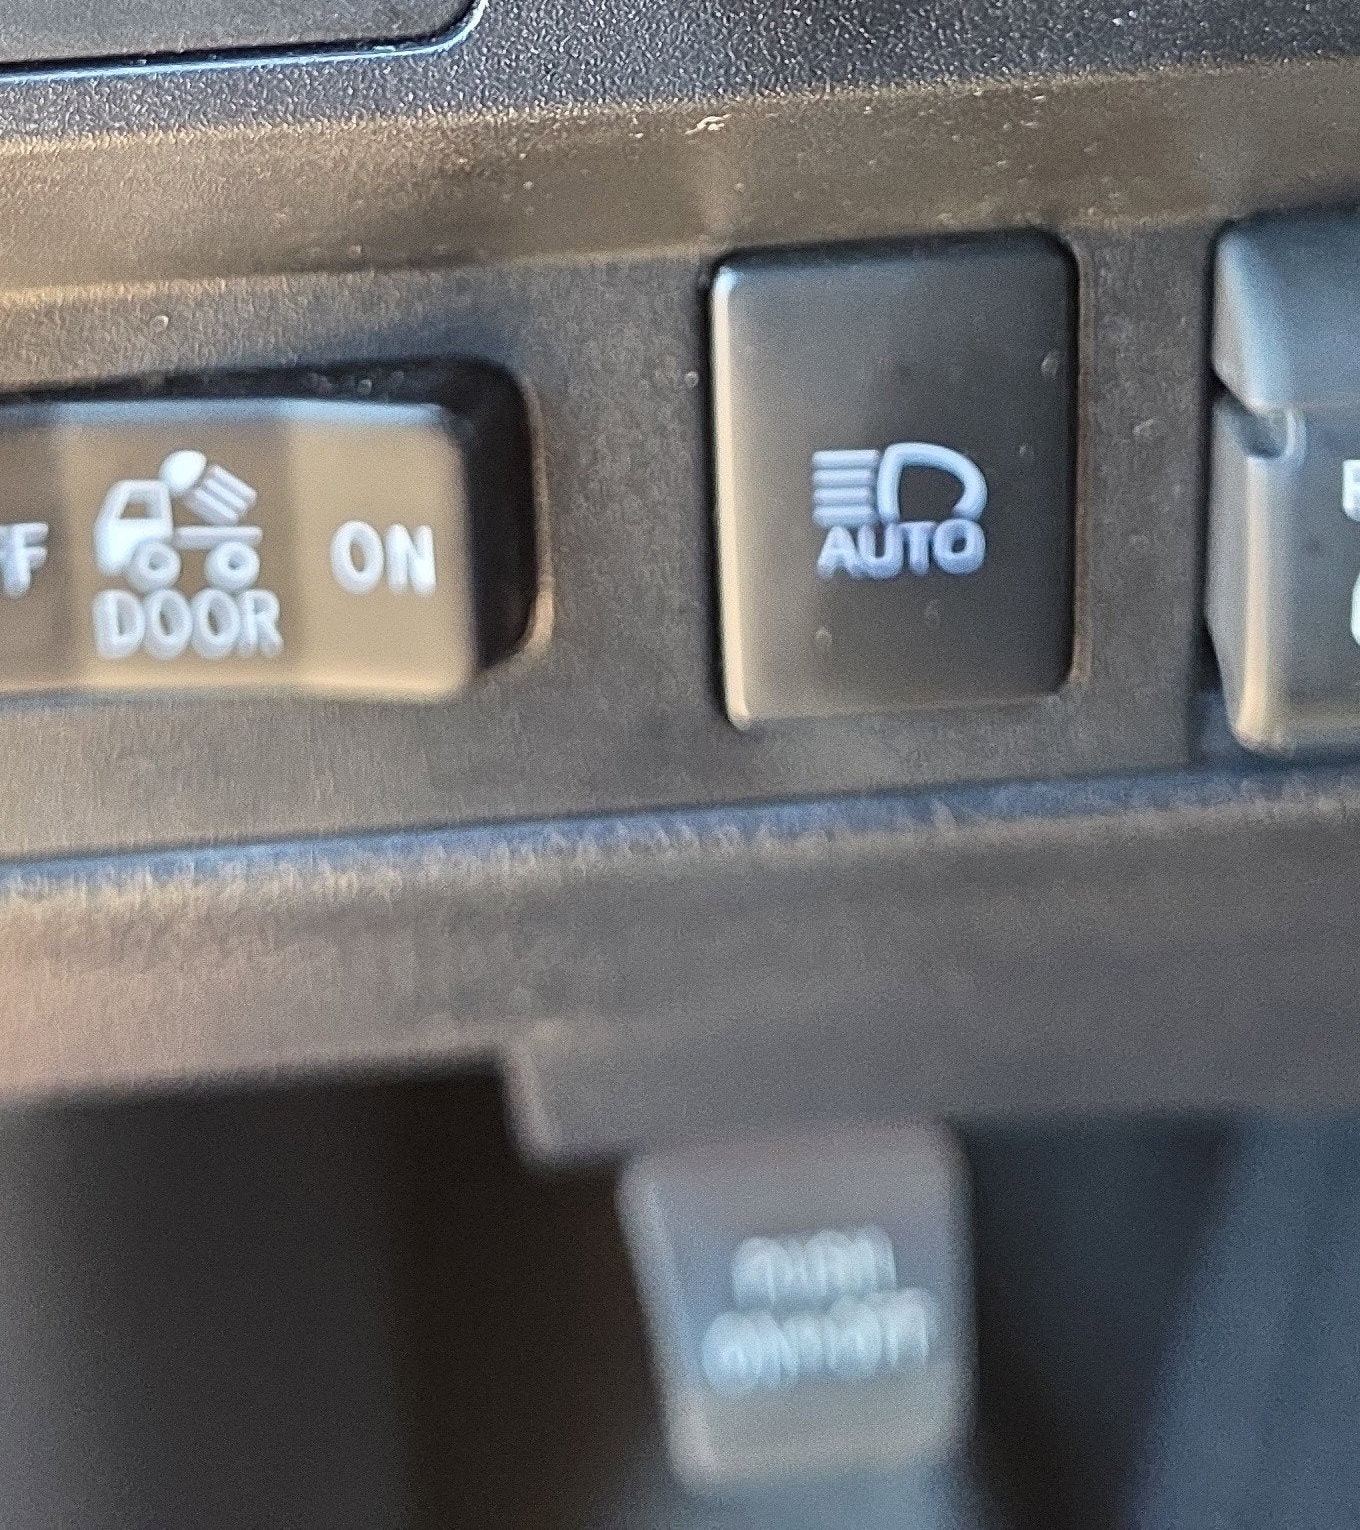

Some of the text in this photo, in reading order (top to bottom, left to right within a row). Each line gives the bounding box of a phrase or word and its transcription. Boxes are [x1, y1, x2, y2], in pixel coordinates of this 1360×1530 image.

[328, 519, 437, 597] ON
[814, 516, 988, 580] AUTO
[91, 587, 285, 661] DOOR
